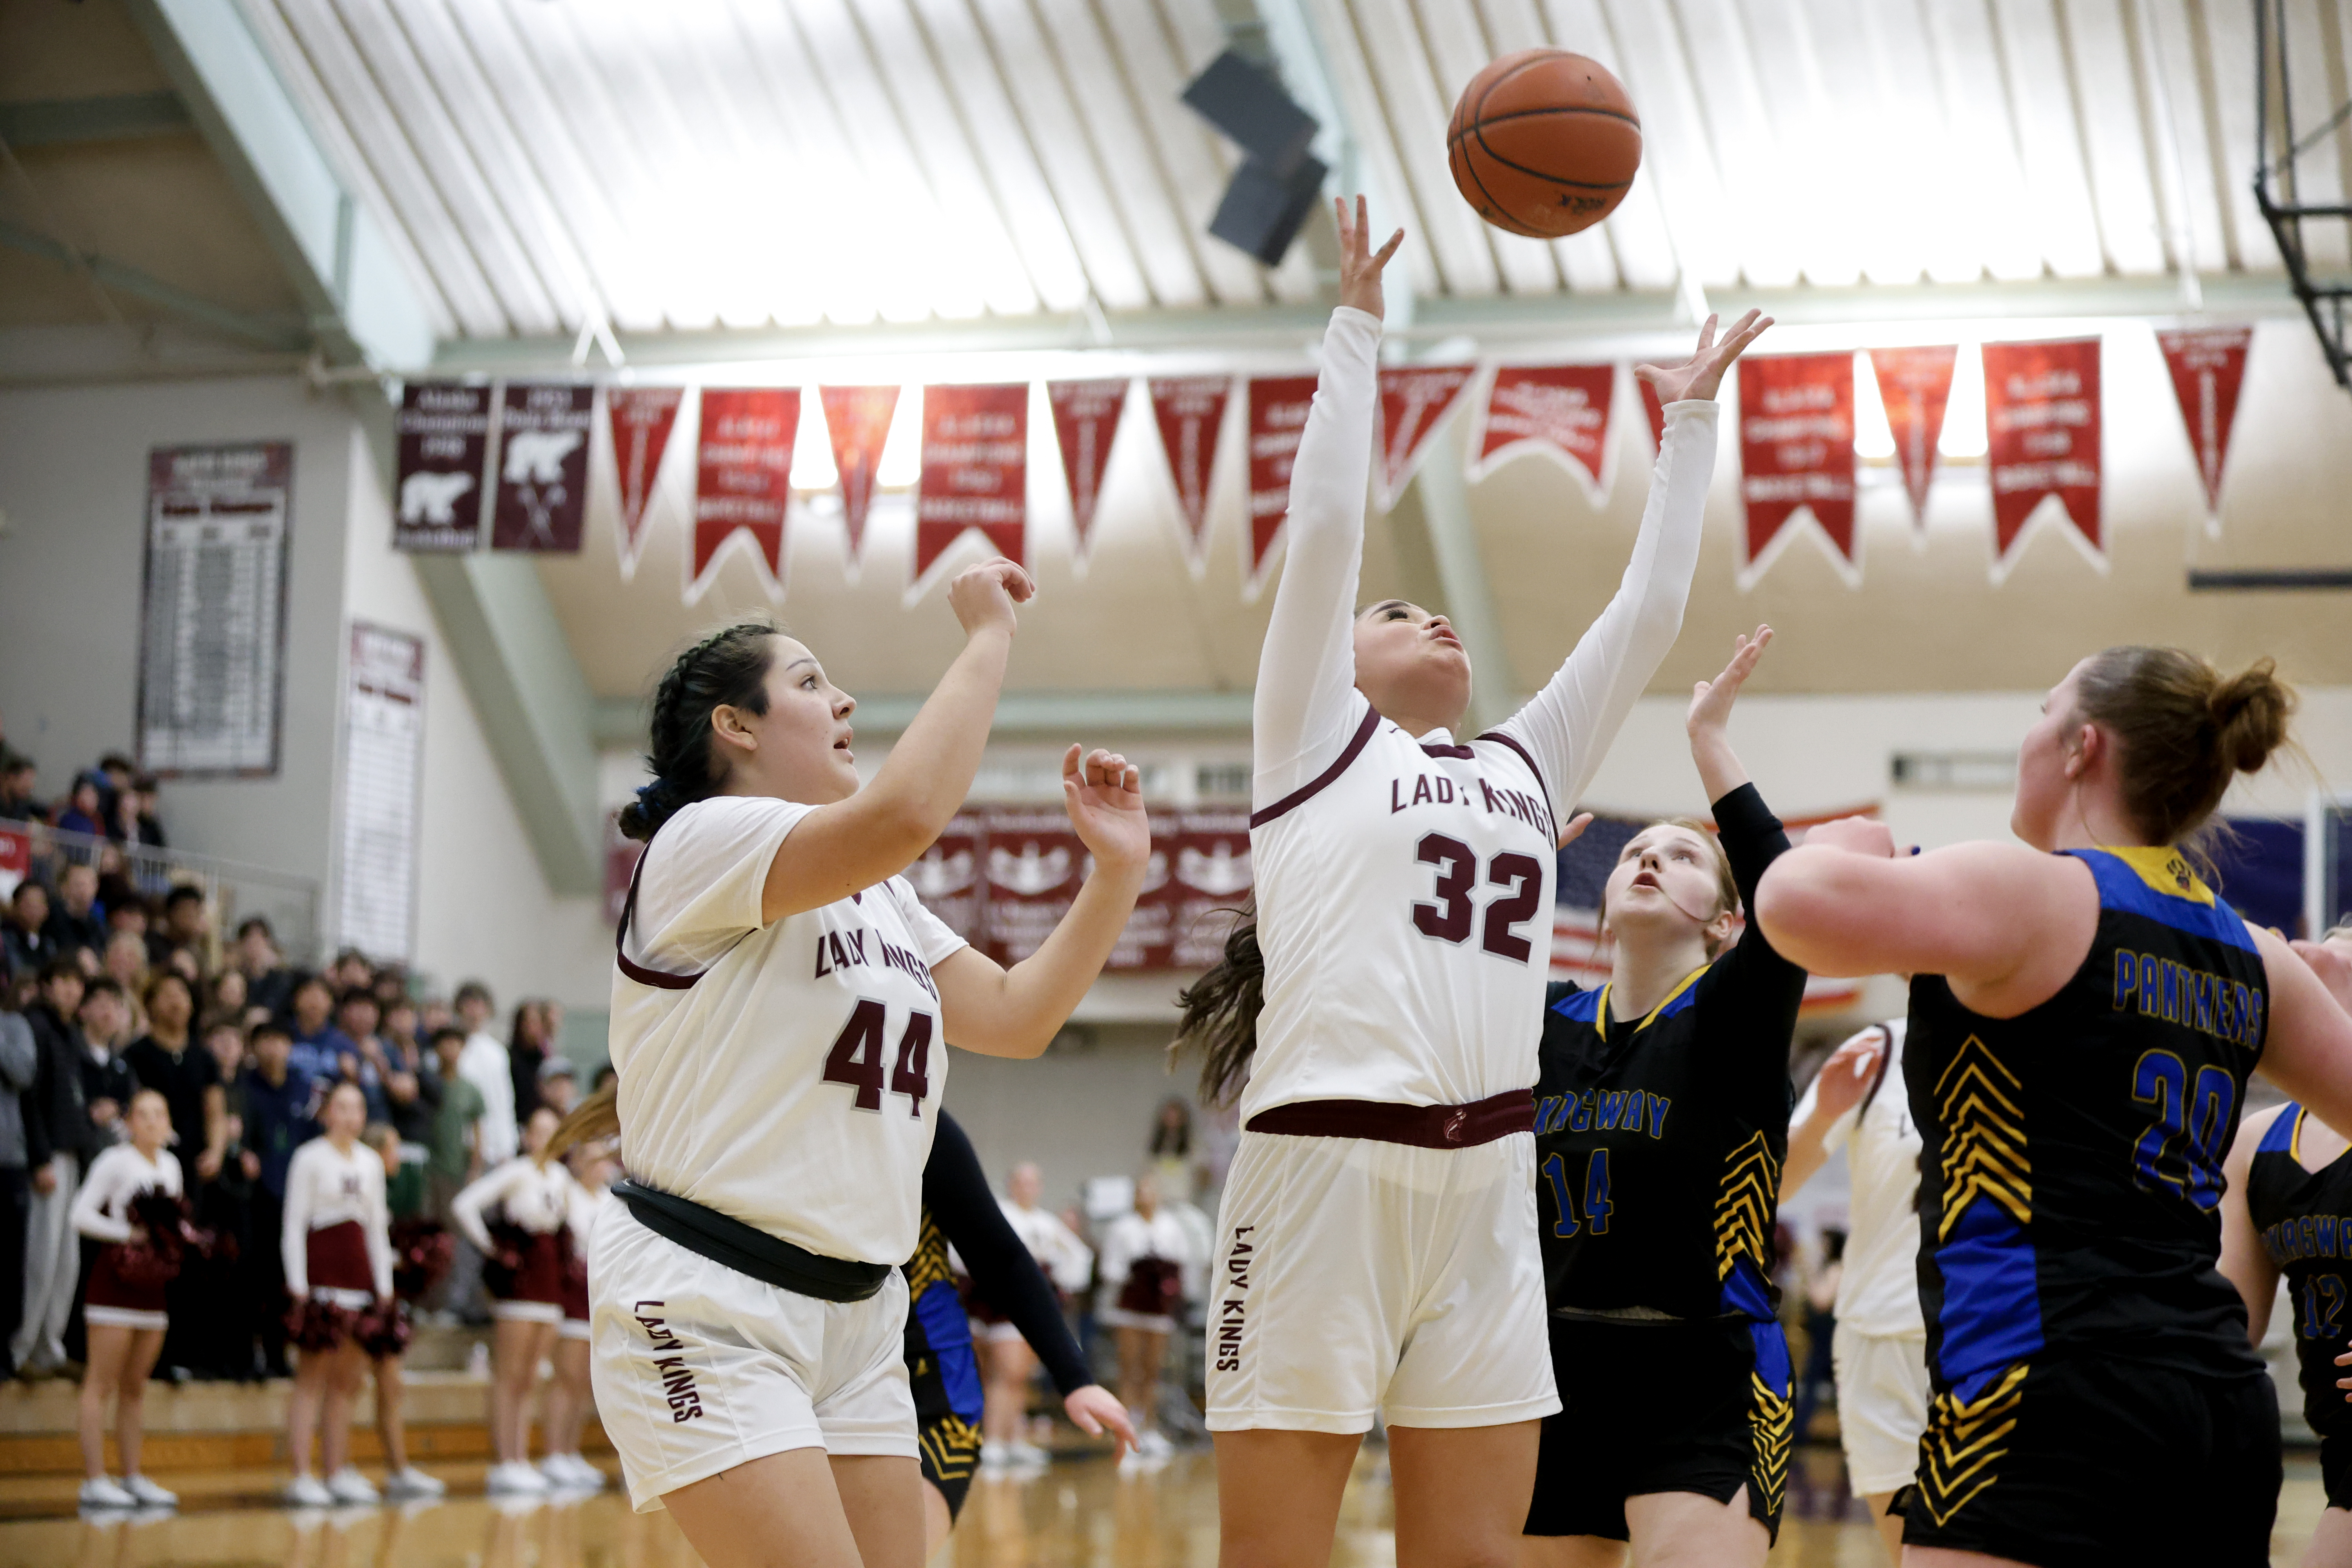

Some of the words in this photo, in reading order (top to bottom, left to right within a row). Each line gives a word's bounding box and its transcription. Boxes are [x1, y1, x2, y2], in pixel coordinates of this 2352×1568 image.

[1478, 777, 1554, 852] KINGS
[1408, 829, 1543, 968] 32
[875, 928, 938, 1004] KNGS
[2112, 948, 2263, 1051] PANTHERS
[818, 995, 933, 1122] 44
[1532, 1087, 1671, 1140] KAGWAY
[2131, 1047, 2236, 1214] 20
[1541, 1148, 1614, 1238] 14
[1229, 1225, 1254, 1289] LADY
[634, 1301, 684, 1350] LADY
[1216, 1299, 1244, 1372] KINGS
[2301, 1273, 2347, 1340] 12
[653, 1357, 703, 1423] KINGS
